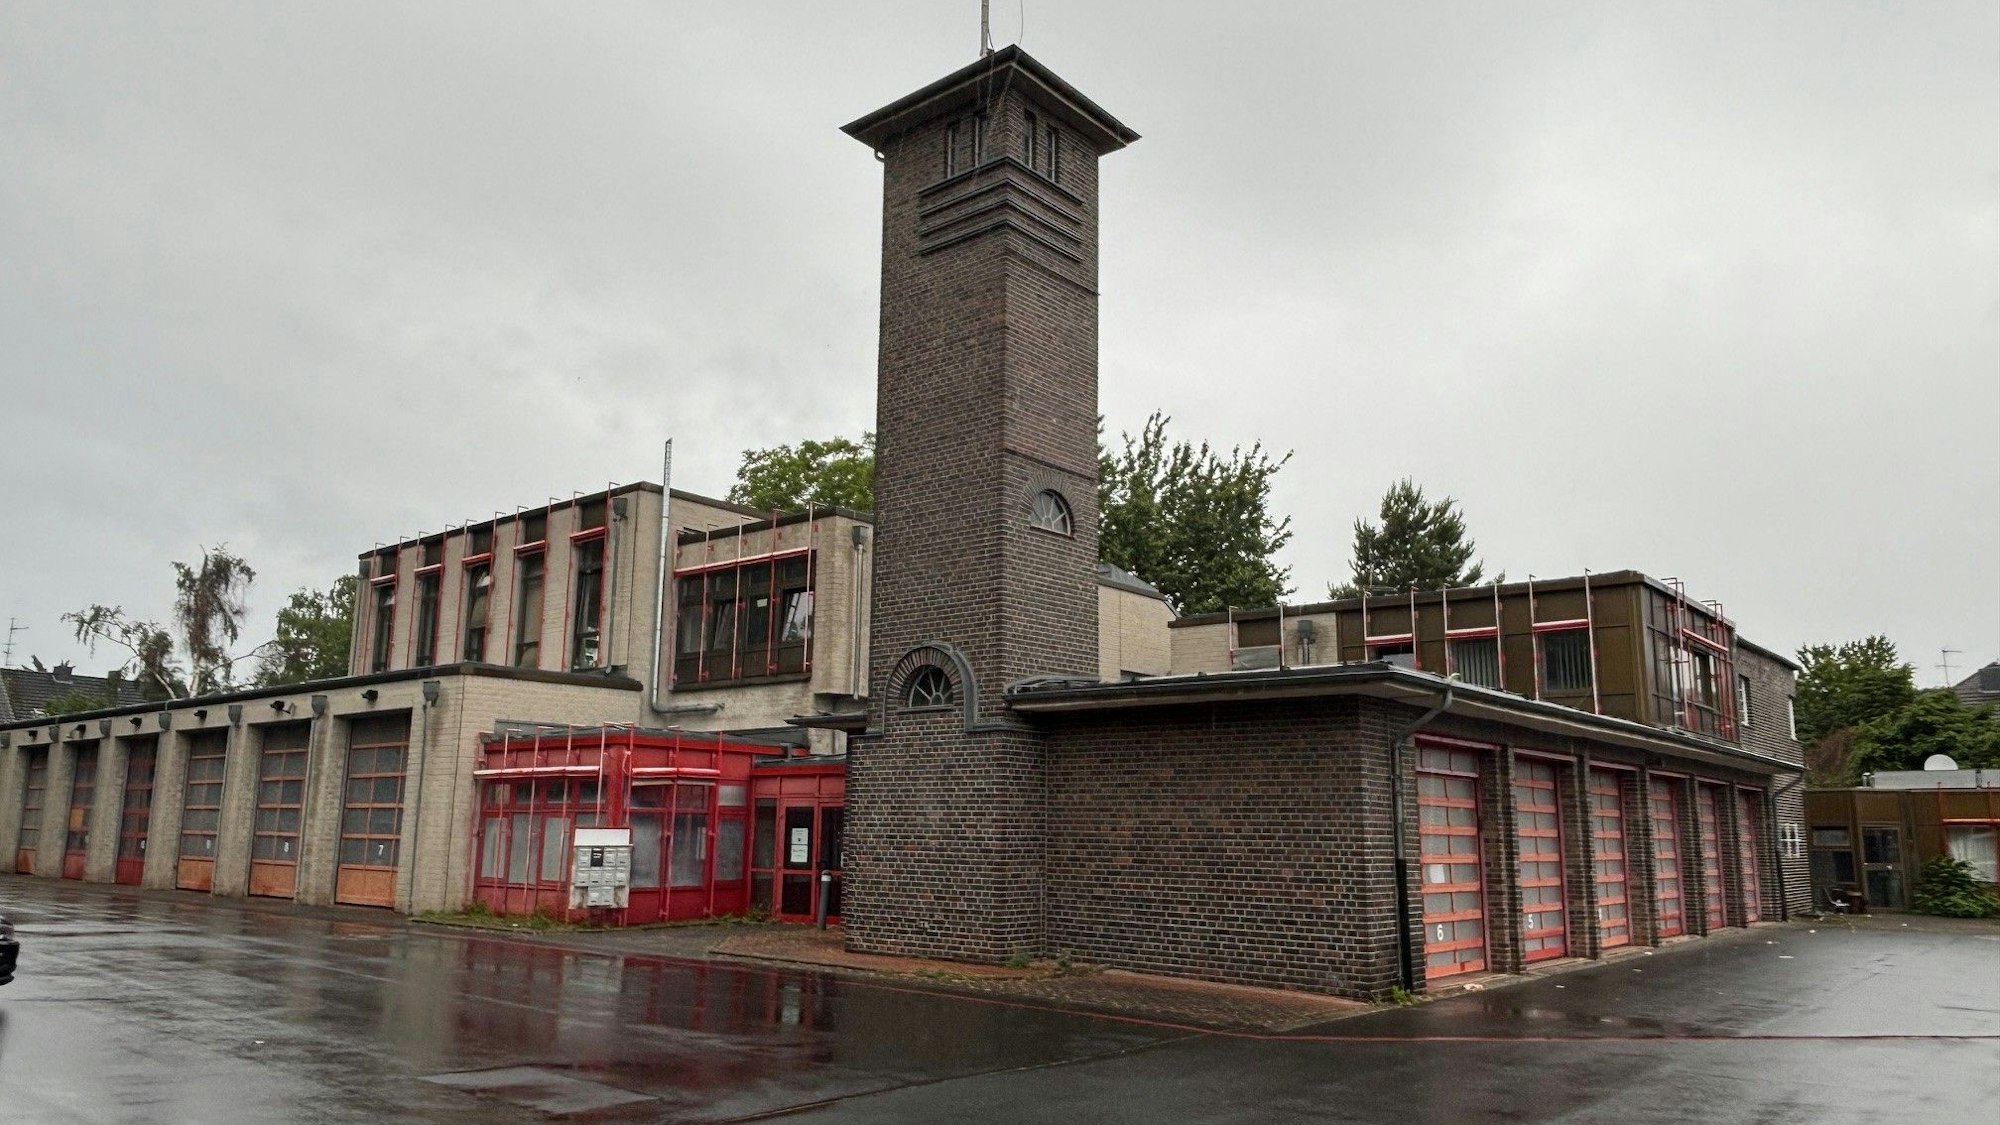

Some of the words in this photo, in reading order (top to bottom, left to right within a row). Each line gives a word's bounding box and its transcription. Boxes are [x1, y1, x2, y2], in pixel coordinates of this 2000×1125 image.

[378, 844, 384, 856] 7
[1528, 913, 1534, 929] 5
[1437, 924, 1444, 941] 6
